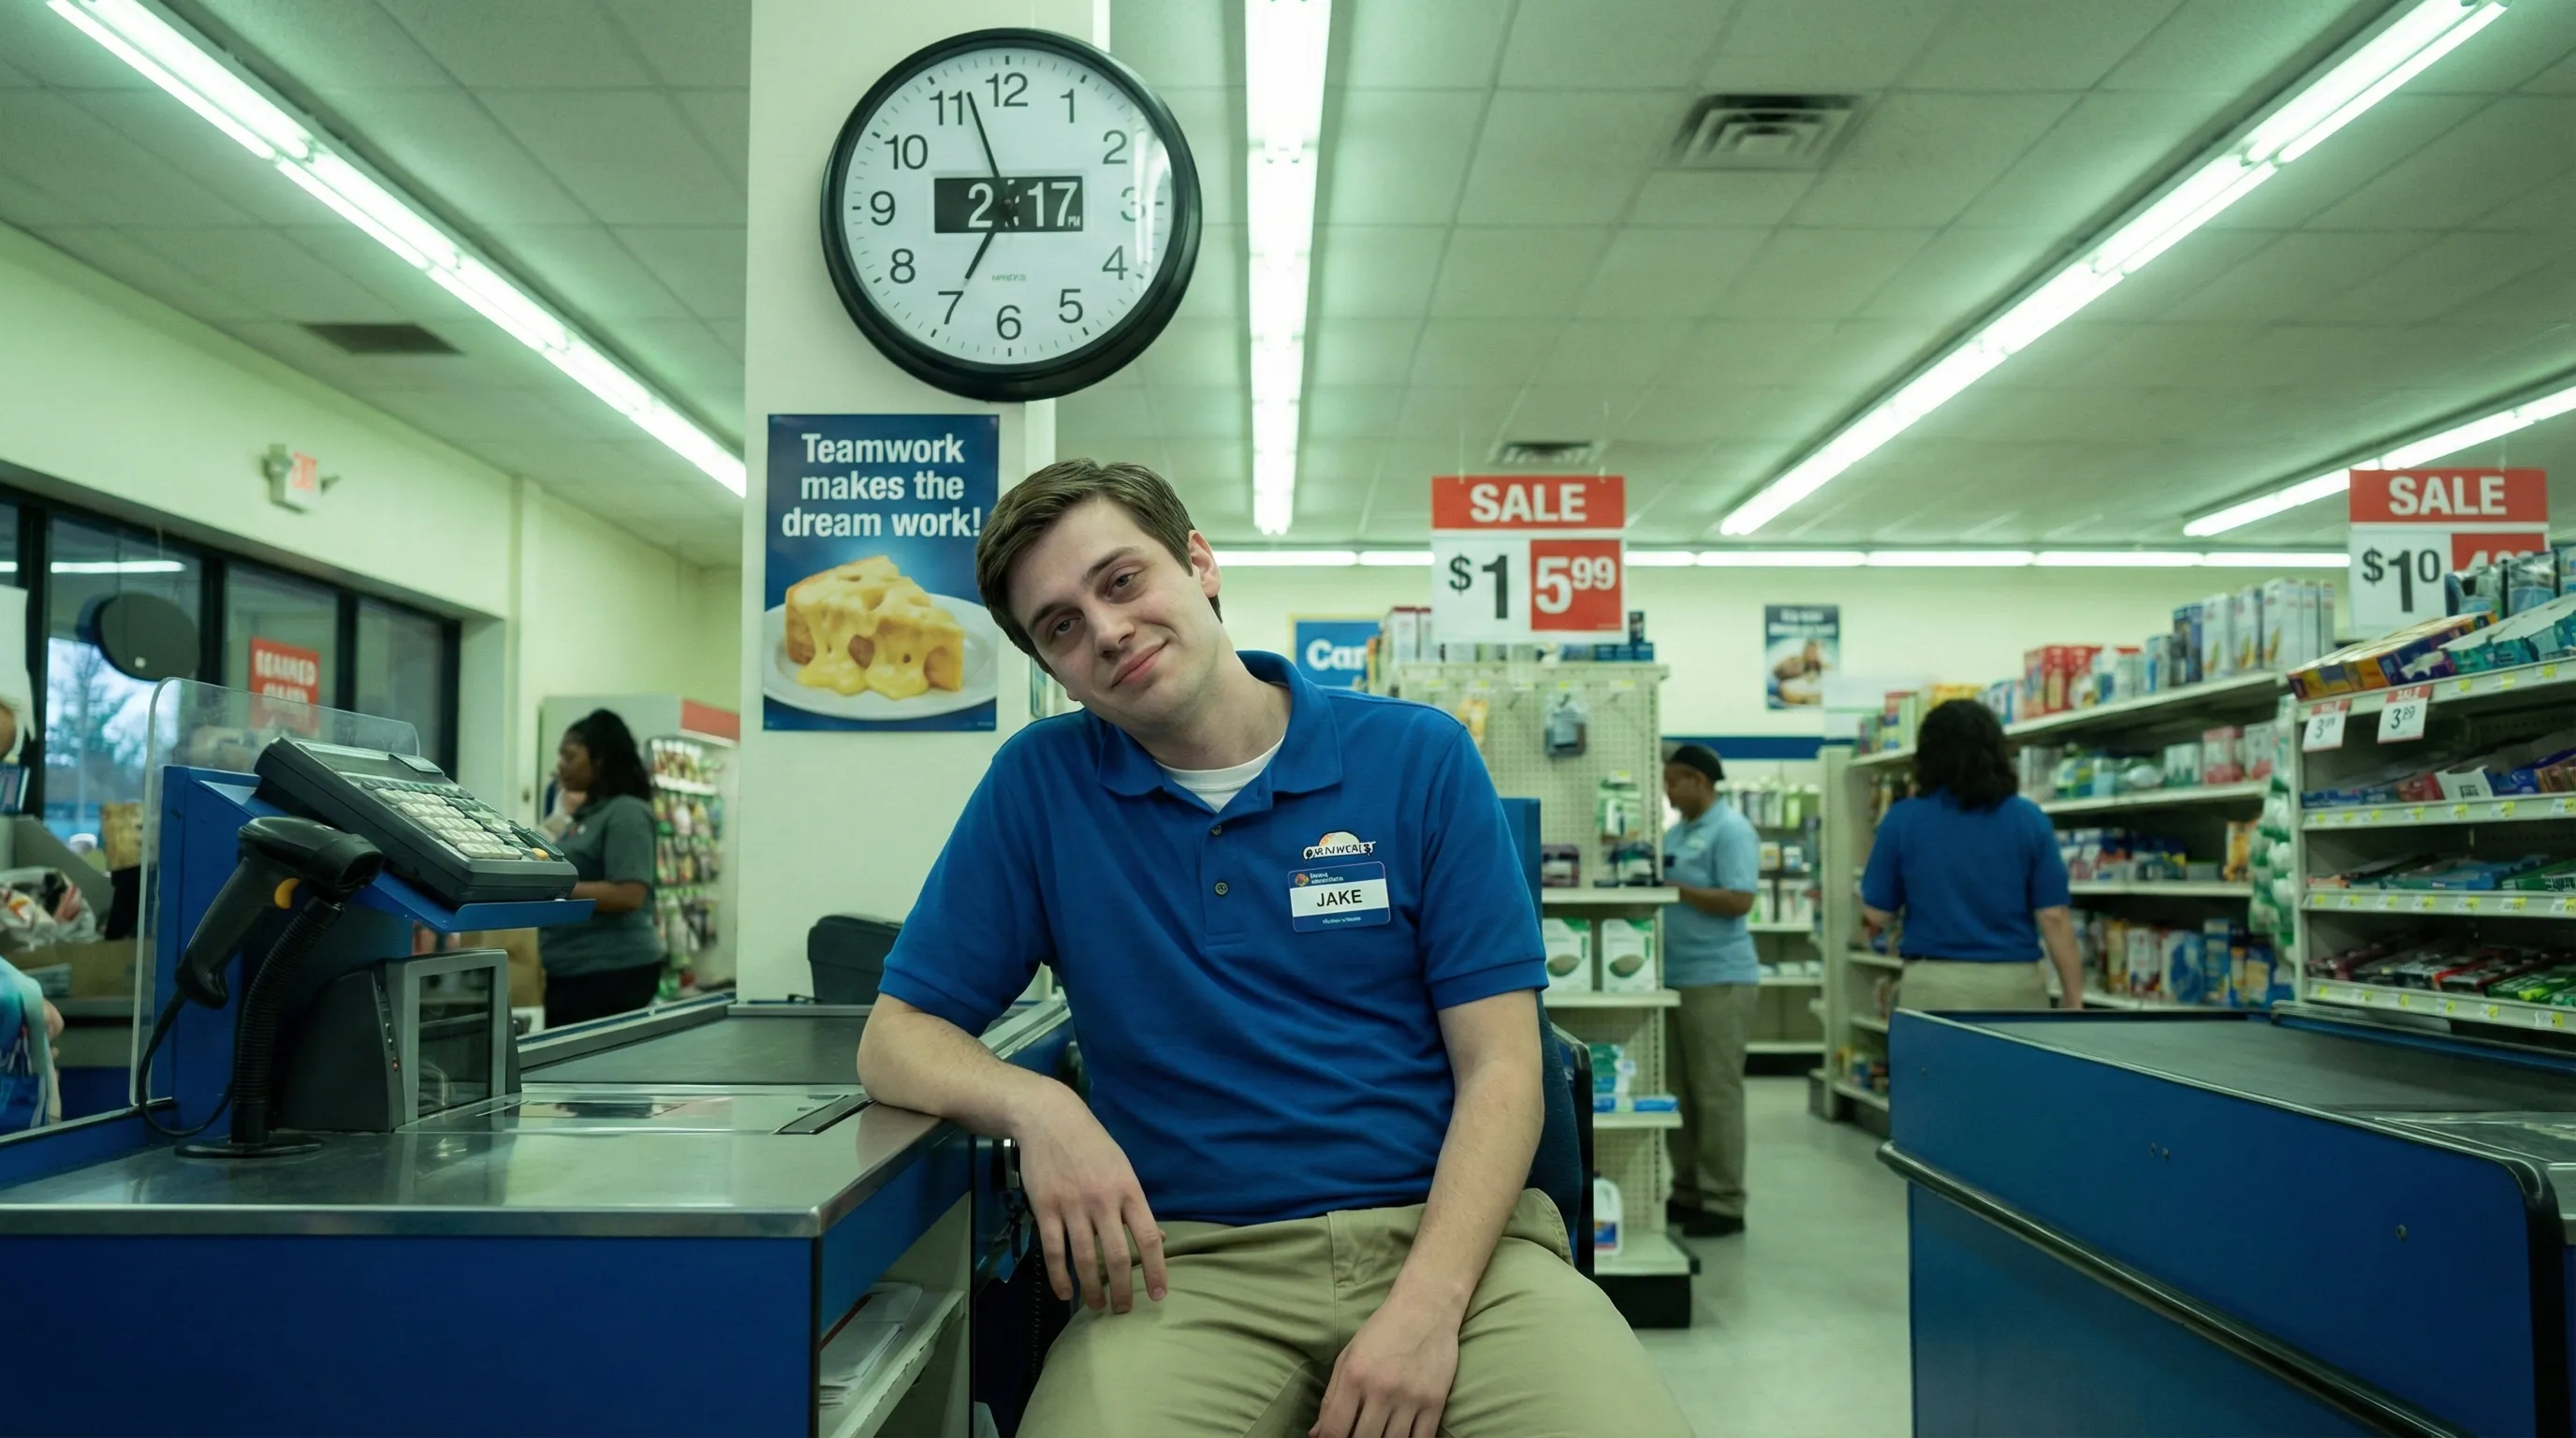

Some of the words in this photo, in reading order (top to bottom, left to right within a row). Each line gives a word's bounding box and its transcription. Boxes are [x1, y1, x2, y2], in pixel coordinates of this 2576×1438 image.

[929, 90, 964, 125] 11
[985, 72, 1029, 108] 12
[1060, 88, 1075, 124] 1
[884, 134, 929, 170] 10
[1102, 129, 1128, 165] 2
[870, 190, 896, 226] 9
[1120, 186, 1147, 222] 3
[889, 248, 916, 284] 8
[1102, 245, 1128, 280] 4
[937, 290, 964, 325] 7
[996, 305, 1022, 340] 6
[1058, 288, 1083, 323] 5
[801, 433, 965, 463] Teamwork
[801, 470, 905, 500] makes
[914, 470, 964, 500] the
[1470, 483, 1588, 522] SALE
[2388, 476, 2507, 516] SALE
[782, 506, 881, 537] dream
[891, 506, 981, 537] work!
[1316, 888, 1363, 907] JAKE
